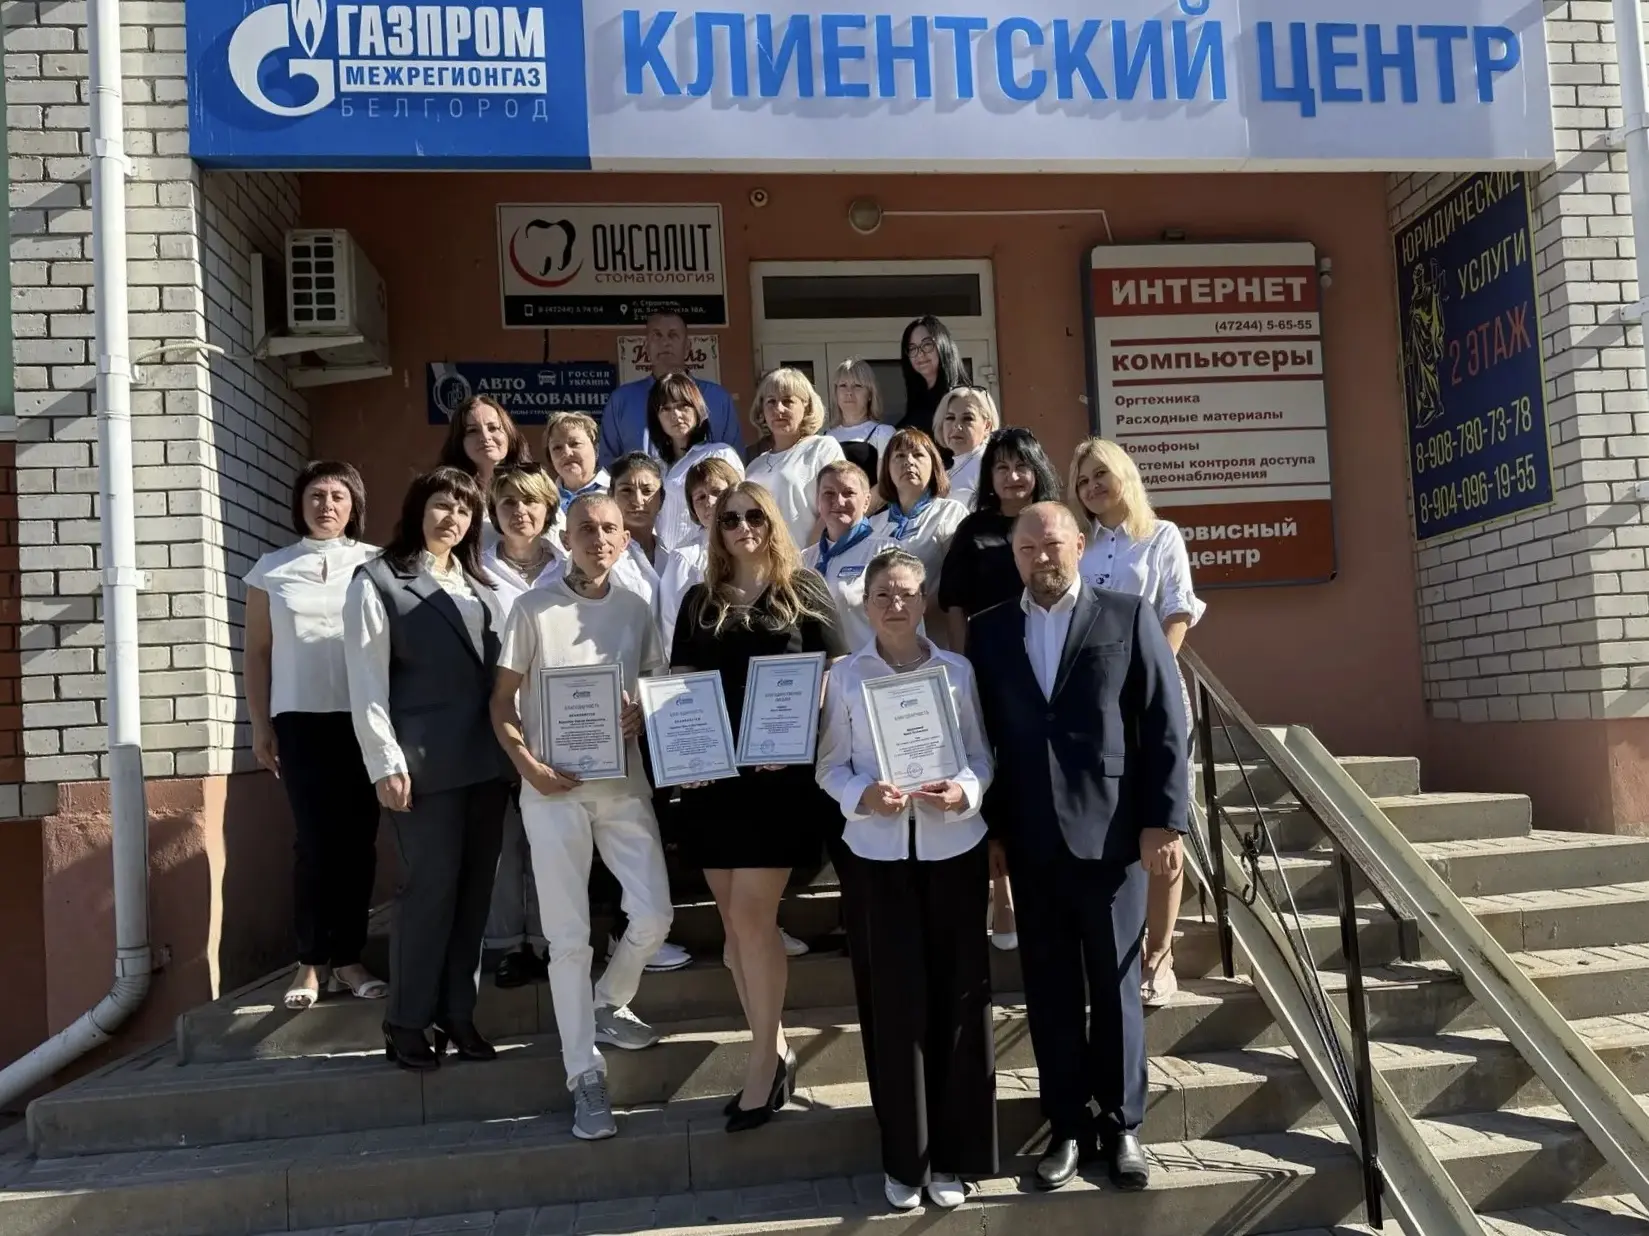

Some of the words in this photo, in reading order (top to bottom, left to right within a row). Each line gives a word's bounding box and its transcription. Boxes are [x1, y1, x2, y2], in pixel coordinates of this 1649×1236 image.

[336, 4, 546, 58] ГАЗПРОМ
[623, 0, 1229, 102] КЛИЕНТСКИЙ
[1257, 21, 1521, 117] ЦЕНТР
[345, 65, 542, 87] МЕЖРЕГИОНГАЗ
[340, 97, 550, 123] БЕЛГОРОД
[1402, 171, 1520, 266] ЮРИДИЧЕСКИЕ
[592, 223, 713, 272] ОКСАЛИТ
[1457, 228, 1527, 299] УСЛУГИ
[594, 273, 716, 284] стоматология
[1112, 277, 1307, 305] ИНТЕРНЕТ
[1215, 321, 1263, 333] (47244)
[1266, 320, 1312, 330] 5-65-55
[1450, 340, 1462, 386] 2
[1466, 301, 1532, 376] ЭТАЖ
[1112, 349, 1313, 372] компьютеры
[478, 378, 526, 390] АВТО
[1115, 394, 1200, 408] Оргтехника
[1116, 413, 1198, 427] Расходные
[1203, 411, 1284, 421] материалы
[1416, 396, 1533, 474] 8-908-780-73-78
[1138, 461, 1185, 470] стемы
[1189, 457, 1256, 469] контроля
[1259, 455, 1316, 467] доступа
[1142, 470, 1268, 484] идеонаблюдения
[1419, 453, 1537, 524] 8-904-096-19-55
[1183, 517, 1297, 541] рвисный
